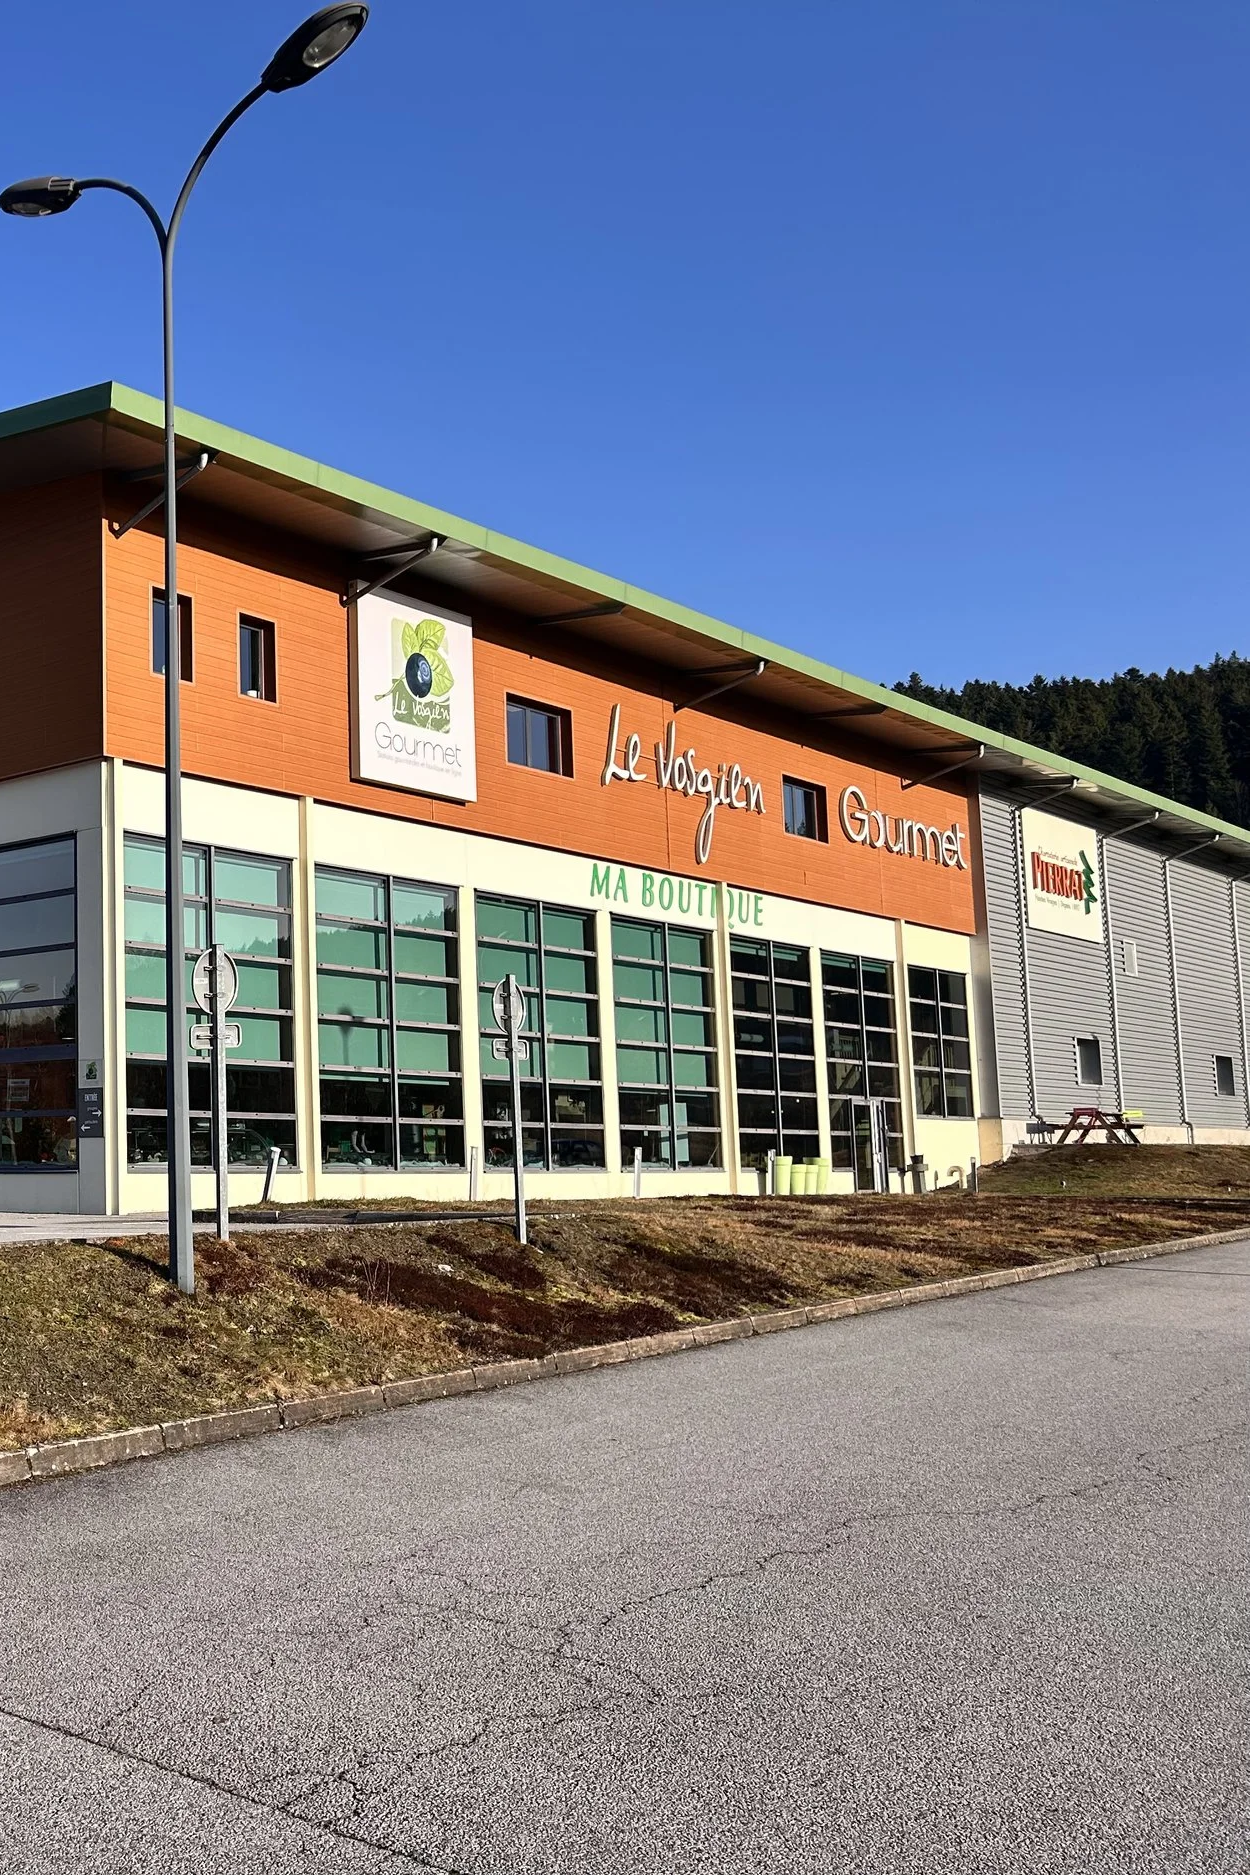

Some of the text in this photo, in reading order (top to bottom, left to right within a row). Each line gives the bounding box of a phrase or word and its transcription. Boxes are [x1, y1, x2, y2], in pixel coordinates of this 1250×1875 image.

[393, 691, 408, 716] Le
[374, 721, 462, 768] Gourmet
[601, 703, 766, 865] Le Vosgien
[838, 785, 968, 871] Gourmet
[590, 862, 629, 903] MA
[1030, 851, 1084, 902] PIERRAT
